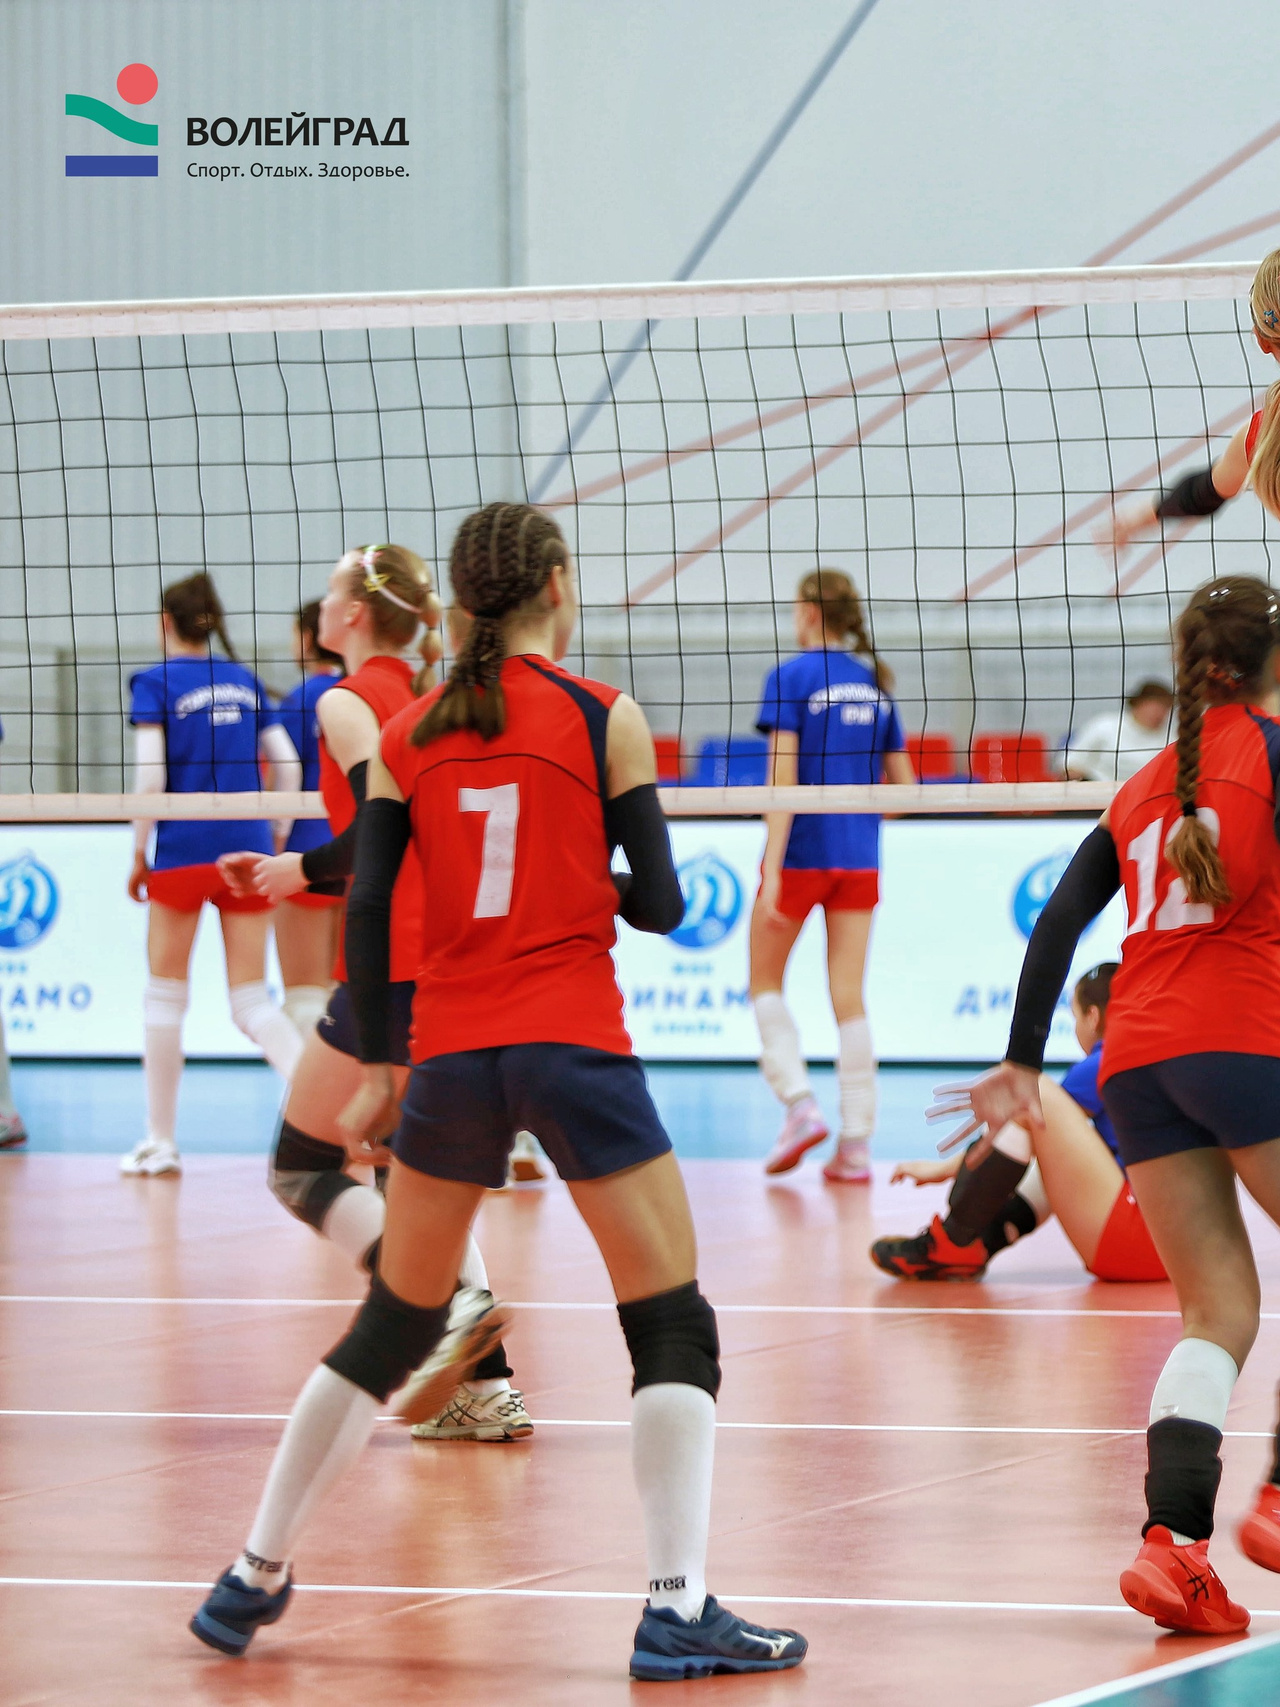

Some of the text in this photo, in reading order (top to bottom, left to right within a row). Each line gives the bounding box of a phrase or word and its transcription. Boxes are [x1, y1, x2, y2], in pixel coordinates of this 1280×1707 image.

[458, 783, 520, 919] 7
[1126, 806, 1221, 937] 12
[0, 984, 92, 1012] АМО
